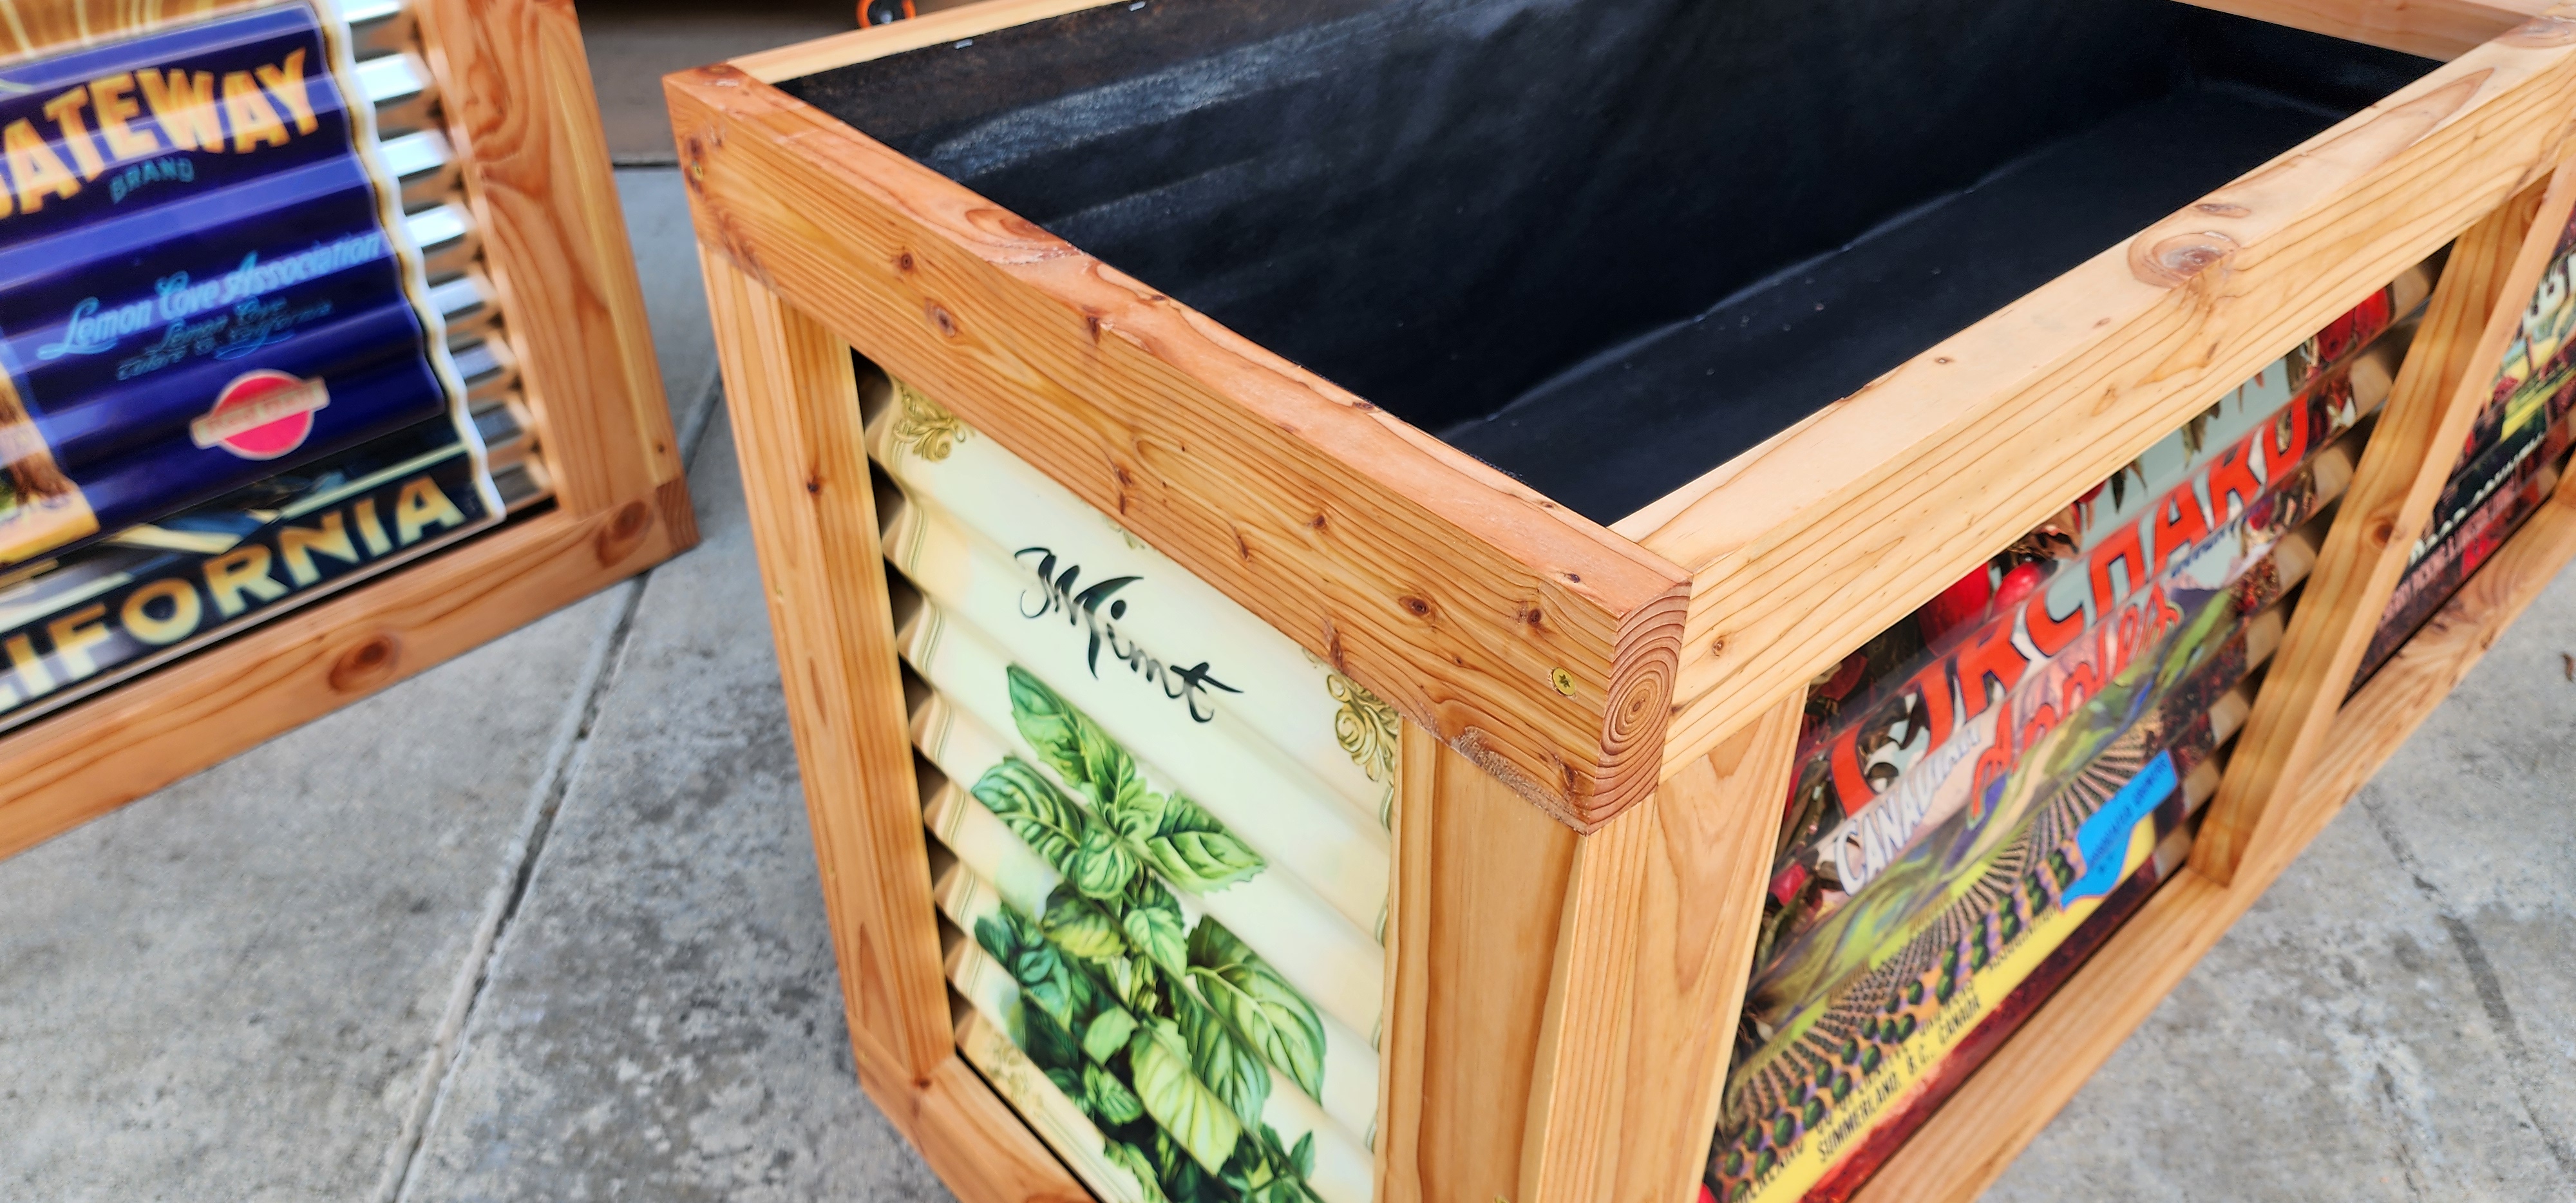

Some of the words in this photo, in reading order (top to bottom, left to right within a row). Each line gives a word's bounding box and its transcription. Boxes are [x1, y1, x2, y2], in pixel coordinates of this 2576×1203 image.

[0, 48, 319, 219] ATEWAY
[109, 156, 194, 204] BRAND
[37, 297, 152, 361] Lemon
[155, 270, 220, 319] Cove
[222, 232, 383, 305] Association
[1014, 547, 1244, 723] Mint
